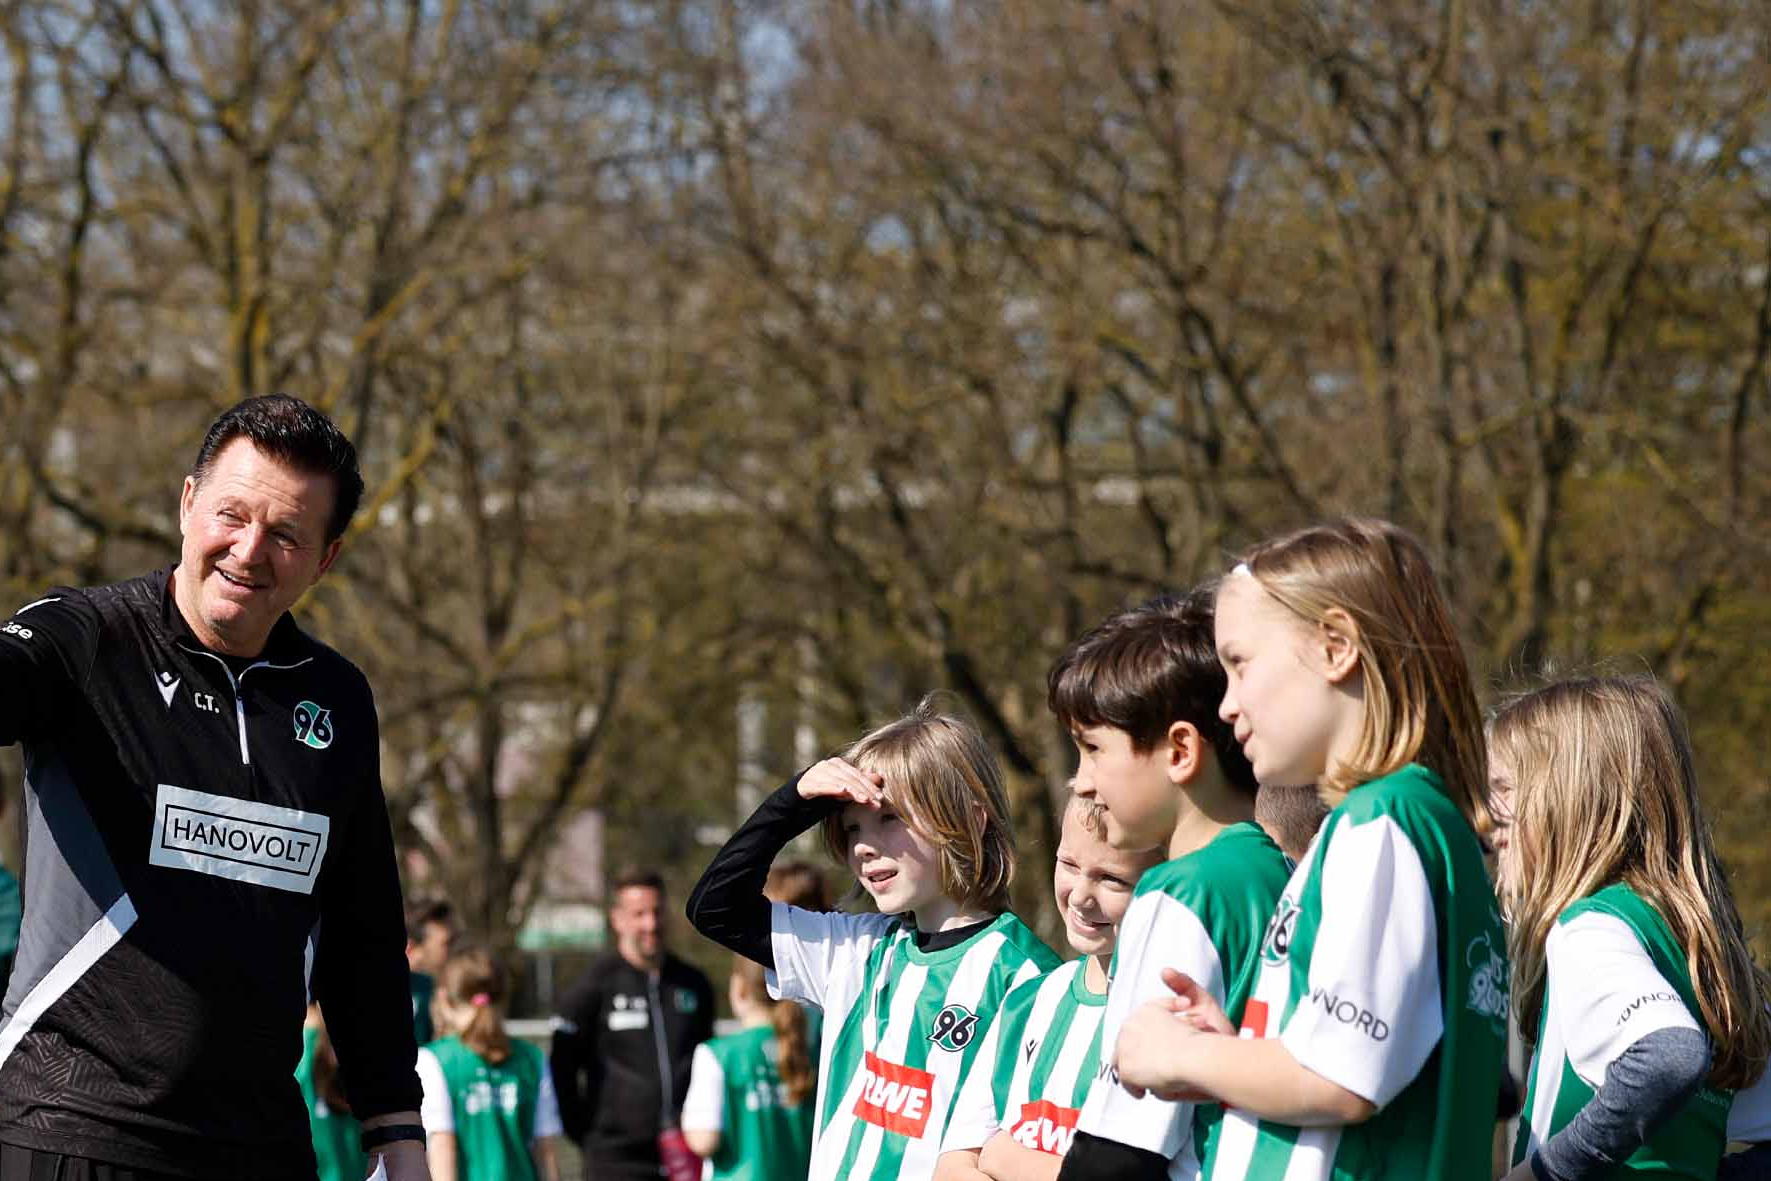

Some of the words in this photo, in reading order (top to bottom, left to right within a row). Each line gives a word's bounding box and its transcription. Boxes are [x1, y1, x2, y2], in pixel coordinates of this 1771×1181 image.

[194, 692, 220, 714] C.T.
[293, 701, 334, 749] 96
[173, 818, 311, 863] HANOVOLT
[927, 1004, 982, 1052] 96
